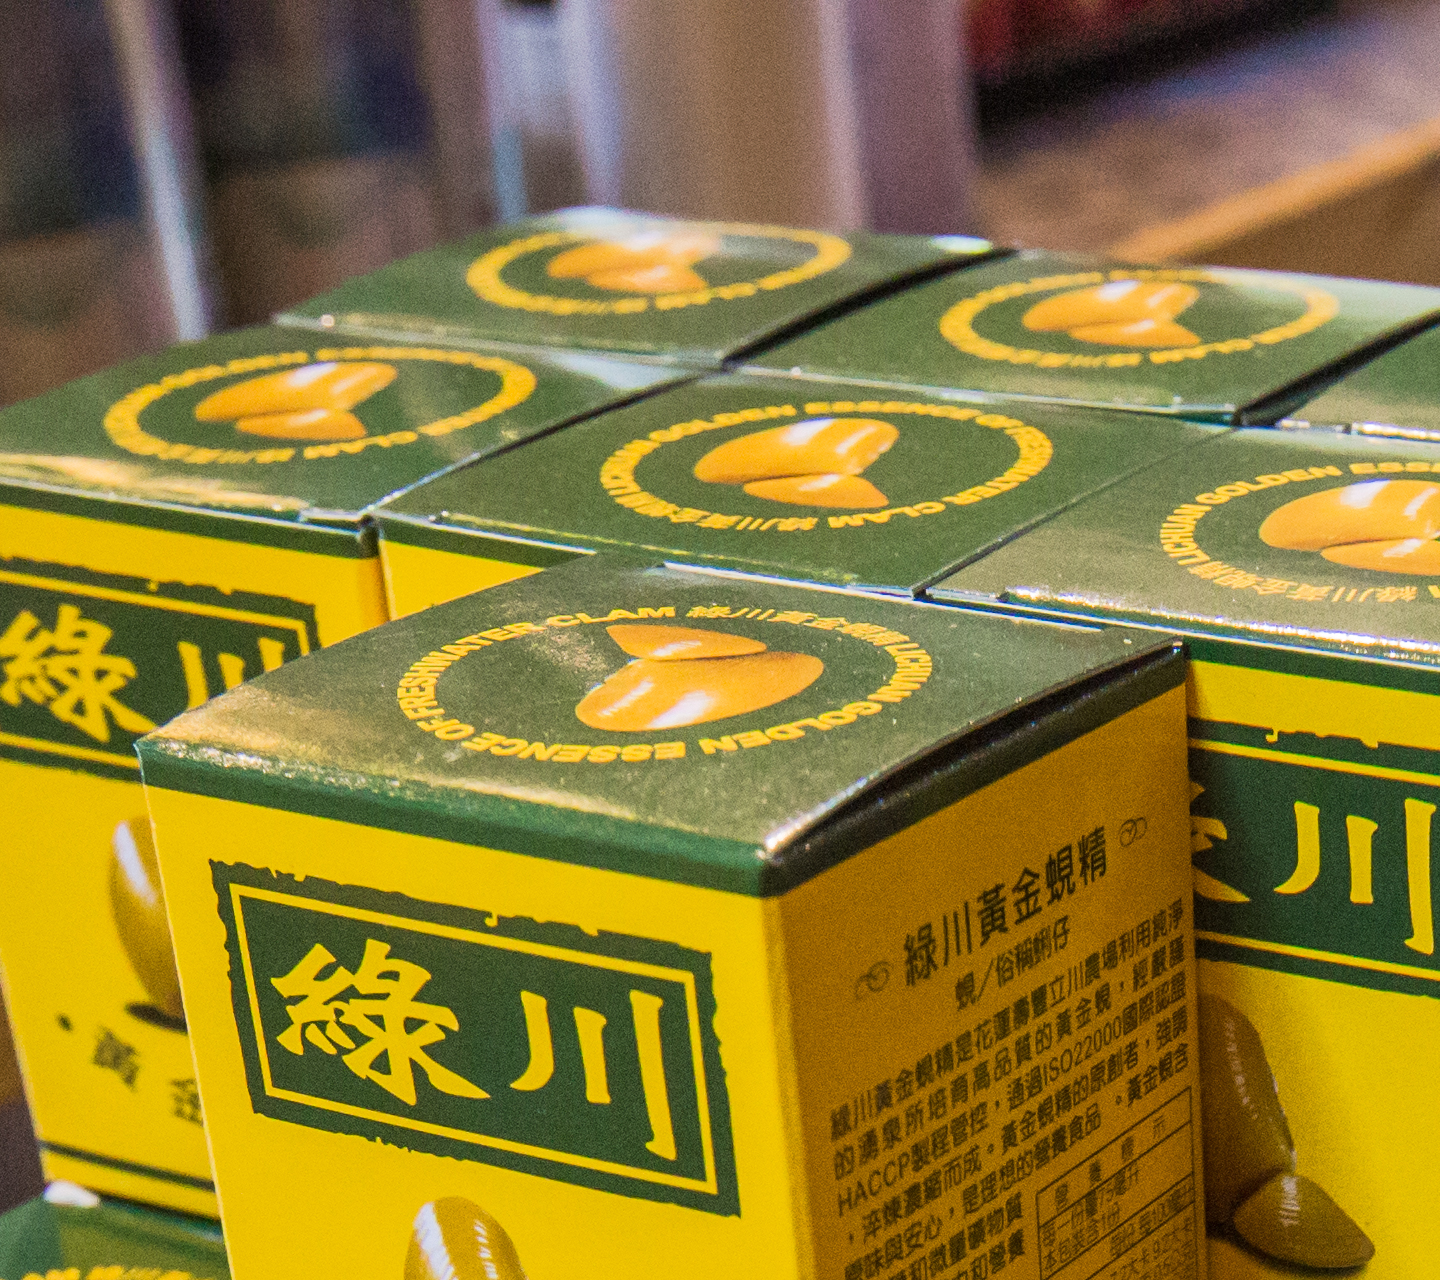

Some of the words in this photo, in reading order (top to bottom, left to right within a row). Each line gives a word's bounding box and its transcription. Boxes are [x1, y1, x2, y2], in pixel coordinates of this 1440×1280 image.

[828, 500, 946, 529] CLAM
[1159, 503, 1213, 566] LICHUAN
[1195, 465, 1343, 505] GOLDEN
[546, 606, 676, 628] CLAM
[397, 622, 546, 720] FRESHWATER
[868, 641, 933, 704] LICHUAN
[417, 716, 476, 741] OF
[461, 732, 686, 764] ESSENCE
[699, 700, 883, 755] GOLDEN
[902, 823, 1107, 990] 綠川黃金蜆精
[271, 939, 677, 1161] 綠川
